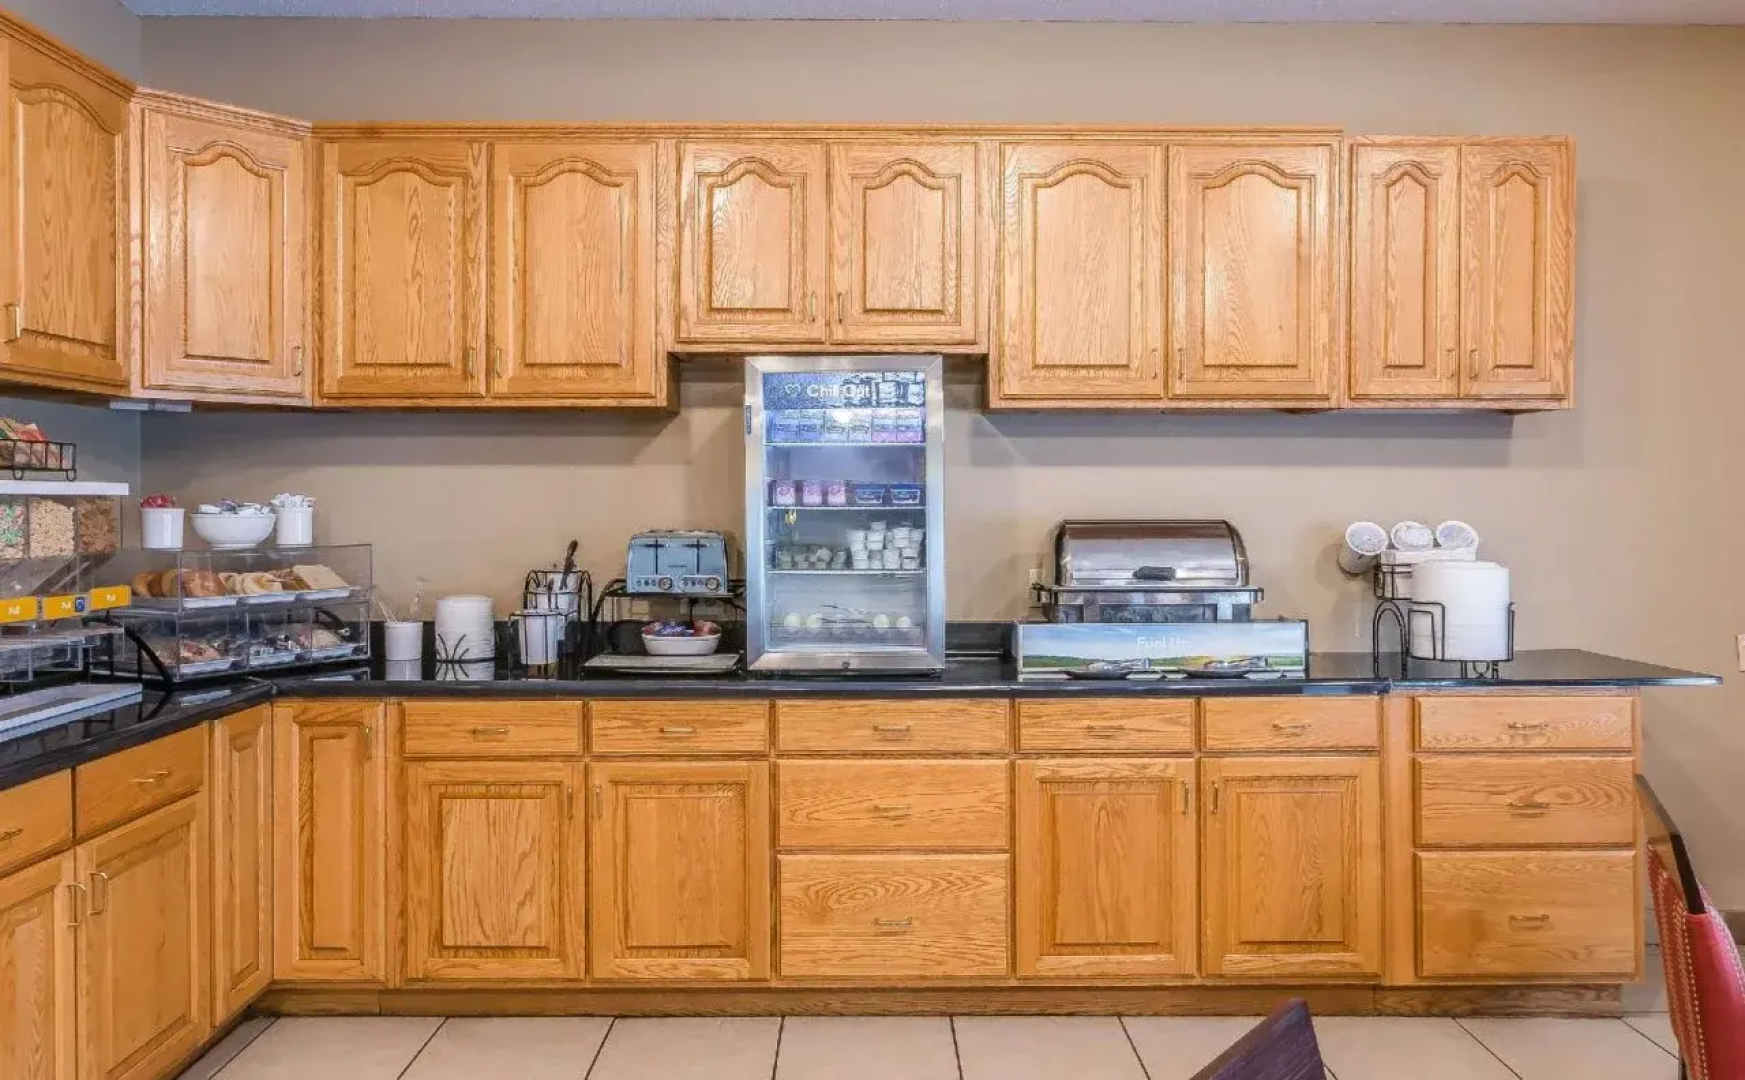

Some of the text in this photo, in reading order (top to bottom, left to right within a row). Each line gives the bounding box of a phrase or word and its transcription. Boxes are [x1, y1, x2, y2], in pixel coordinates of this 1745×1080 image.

[806, 384, 871, 398] Chill Out
[1136, 635, 1167, 649] Fuel
